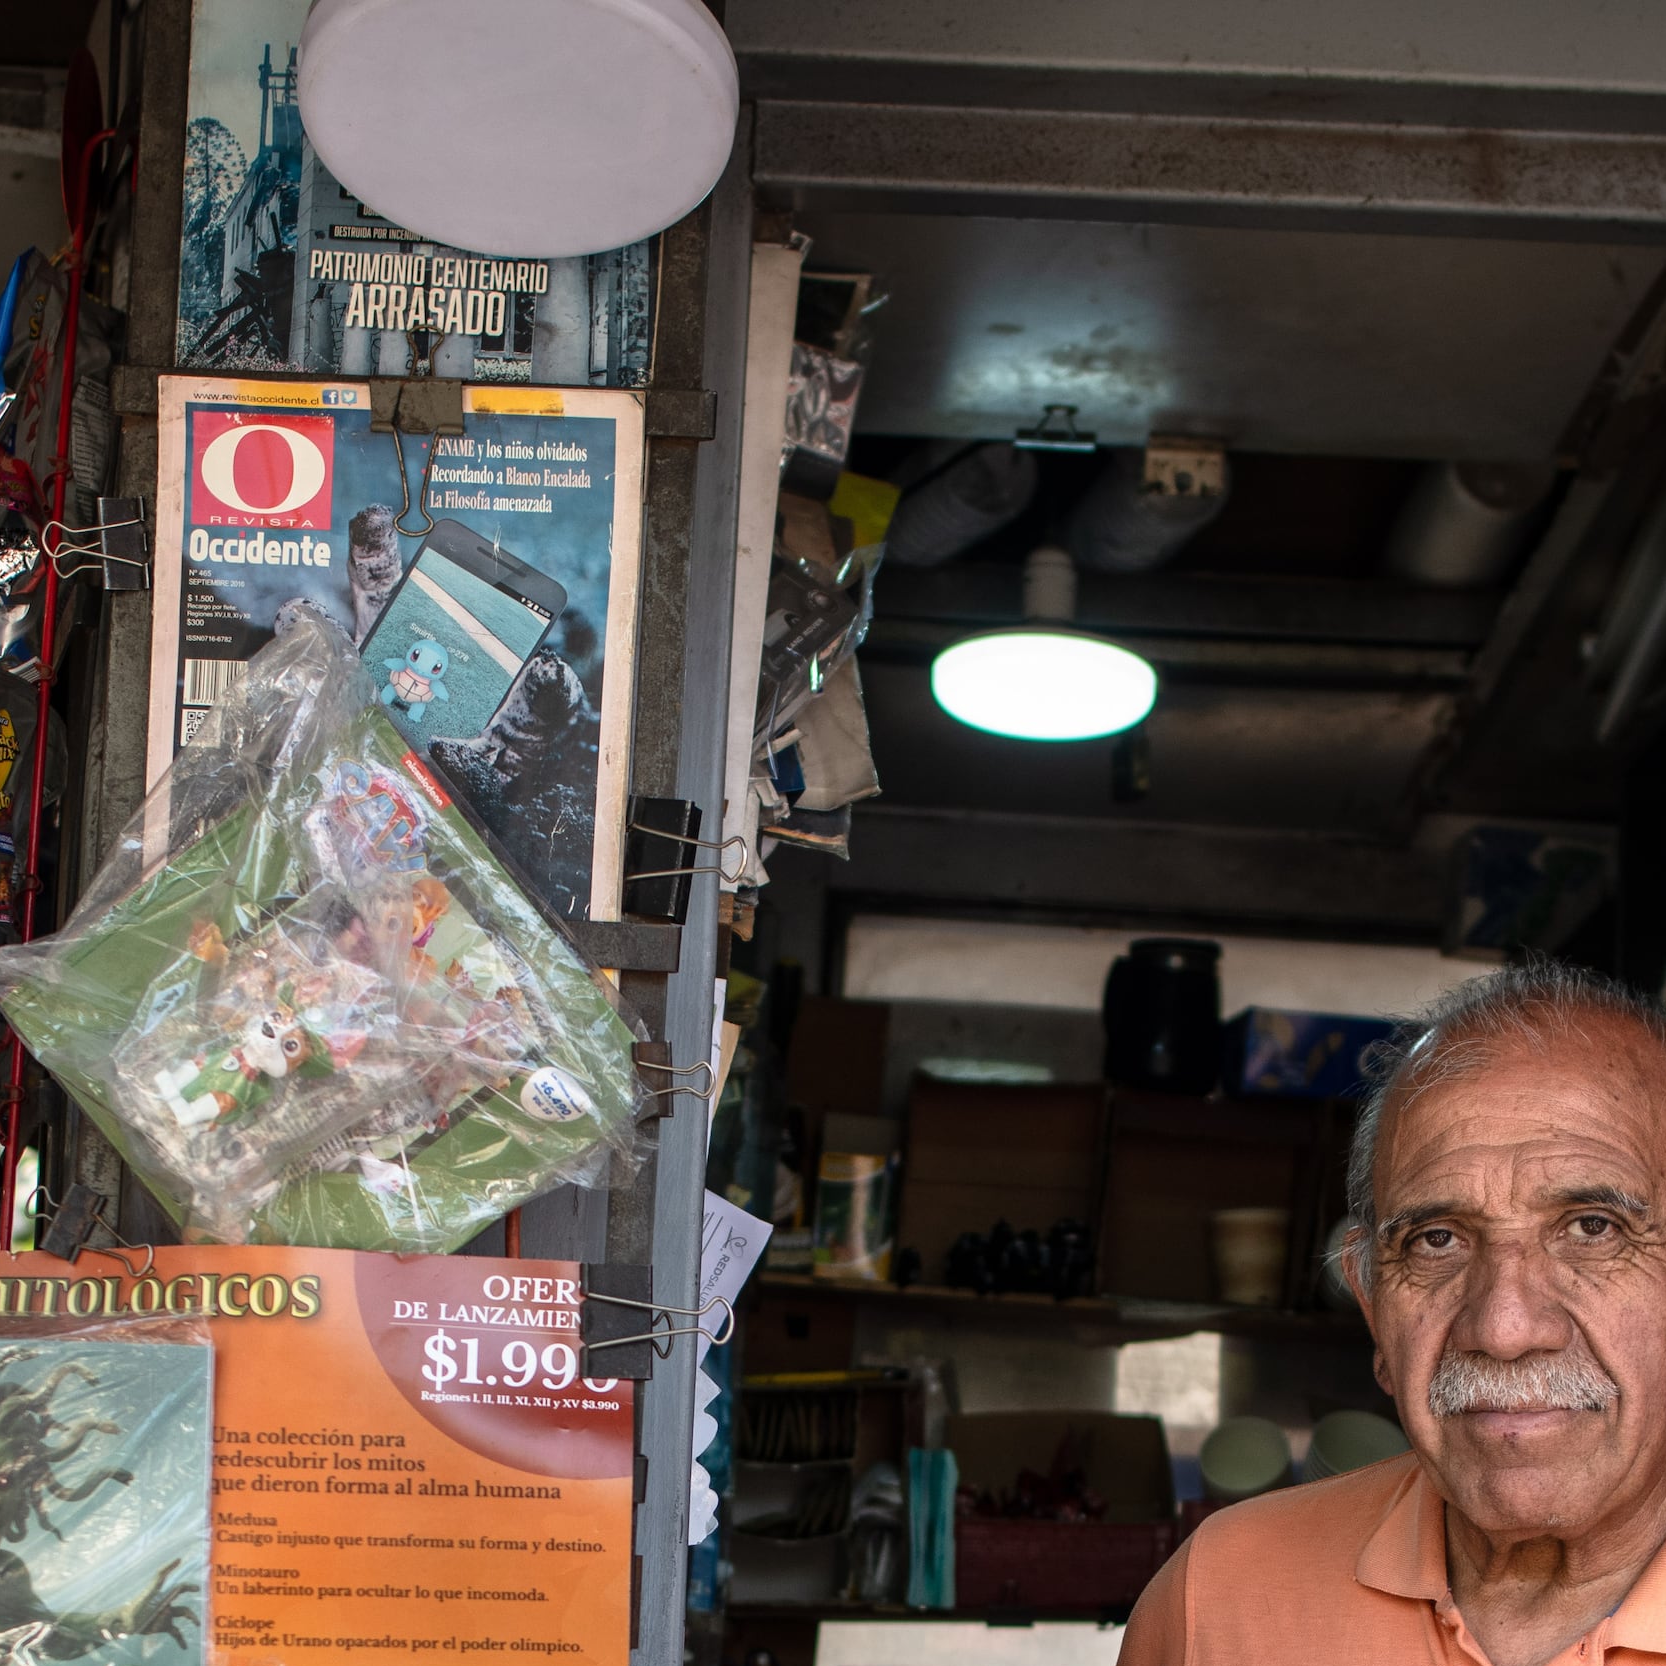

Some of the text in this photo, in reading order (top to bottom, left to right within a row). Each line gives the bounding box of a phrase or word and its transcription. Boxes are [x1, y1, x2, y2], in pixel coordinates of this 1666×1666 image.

[334, 226, 387, 239] DESTRUIDA POR
[310, 250, 549, 294] PATRIMONIO CENTENARIO
[346, 283, 506, 336] ARRASADO
[193, 391, 320, 406] www.revistaoccidente.cl
[477, 444, 484, 463] y
[486, 441, 502, 459] los
[505, 440, 534, 460] niños
[536, 442, 588, 462] olvidados
[201, 424, 326, 515] O
[431, 464, 591, 489] Recordando a Blanco Encalada
[430, 490, 553, 513] La Filosofía amenazada
[210, 515, 314, 528] REVISTA
[189, 528, 331, 568] Occidente
[198, 569, 212, 577] 465
[405, 758, 445, 809] nickelodeon
[482, 1275, 582, 1307] OFER
[393, 1300, 582, 1330] DE LANZAMIEN
[420, 1328, 620, 1394] $1.99
[211, 1426, 406, 1452] Una colección para
[211, 1451, 426, 1472] redescubrir los mitos
[211, 1473, 562, 1500] que dieron forma al alma humana
